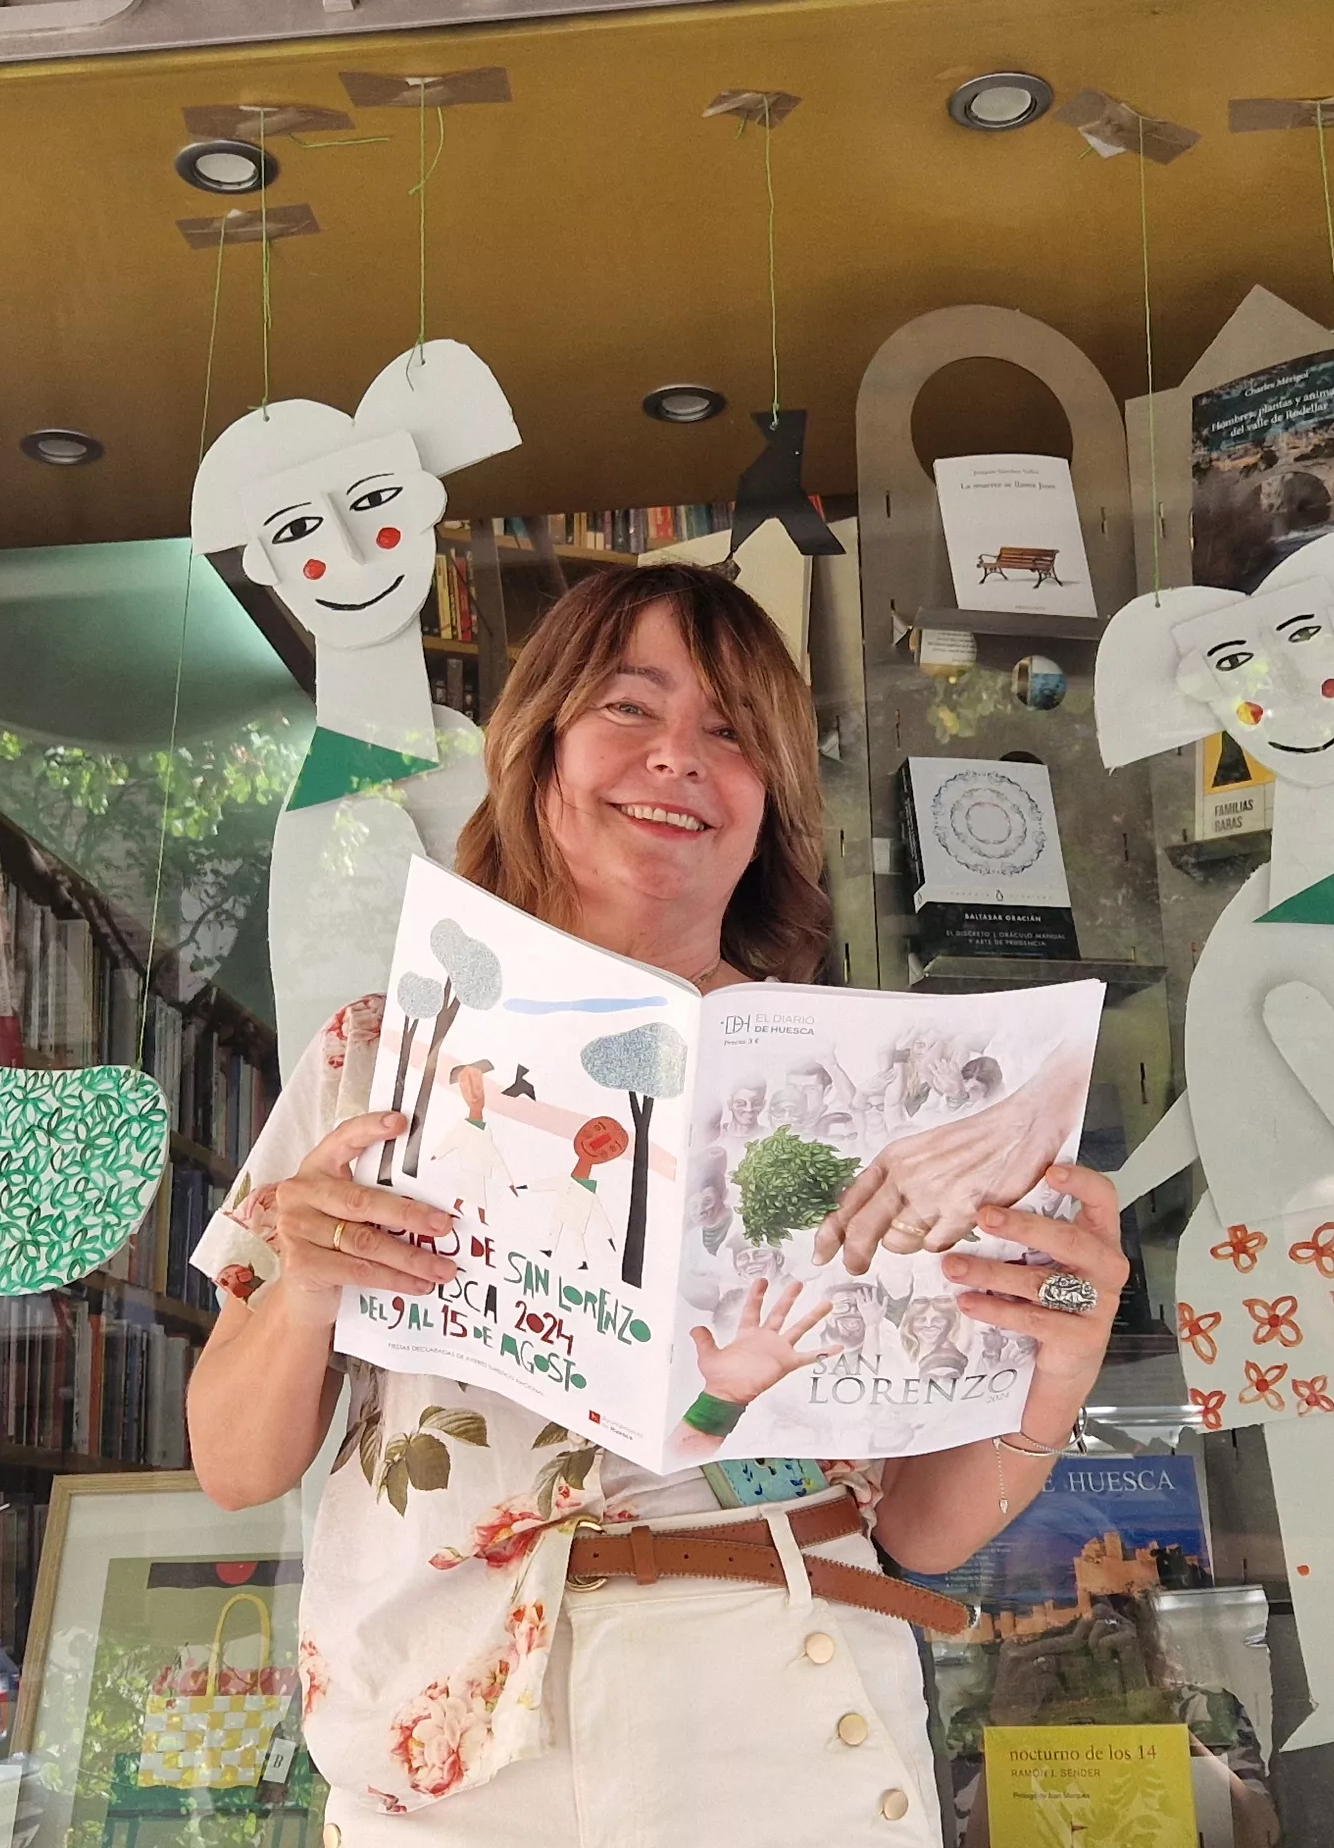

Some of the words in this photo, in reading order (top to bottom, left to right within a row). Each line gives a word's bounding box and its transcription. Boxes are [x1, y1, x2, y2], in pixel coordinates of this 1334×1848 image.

[1245, 383, 1275, 397] Charles
[1257, 398, 1293, 417] plantas
[1295, 396, 1301, 407] y
[1230, 426, 1245, 438] del
[1246, 417, 1269, 431] valle
[1271, 413, 1283, 424] de
[1285, 402, 1328, 420] Rodellar
[1214, 799, 1254, 817] FAMILIAS
[965, 913, 1003, 921] BALTASAR
[1005, 913, 1042, 922] GRACIÁN
[755, 1013, 769, 1023] EL
[773, 1014, 815, 1025] DIARIO
[754, 1025, 769, 1033] DE
[770, 1026, 815, 1035] HUESCA
[470, 1235, 496, 1269] DE
[504, 1251, 549, 1299] SAN
[559, 1275, 652, 1345] LORENZO
[515, 1301, 574, 1356] 2024
[360, 1294, 388, 1322] DEL
[388, 1296, 405, 1330] 9
[408, 1303, 434, 1331] AL
[441, 1304, 468, 1338] 15
[473, 1325, 496, 1349] DE
[500, 1333, 587, 1392] AGOSTO
[812, 1353, 883, 1375] SAN
[808, 1368, 1018, 1405] LORENZO
[1067, 1469, 1176, 1493] HUESCA
[1010, 1749, 1079, 1761] nocturno
[1085, 1744, 1103, 1761] de
[1109, 1744, 1131, 1760] los
[1139, 1744, 1156, 1760] 14
[1011, 1767, 1047, 1778] RAMÓN
[1060, 1769, 1101, 1778] SENDER
